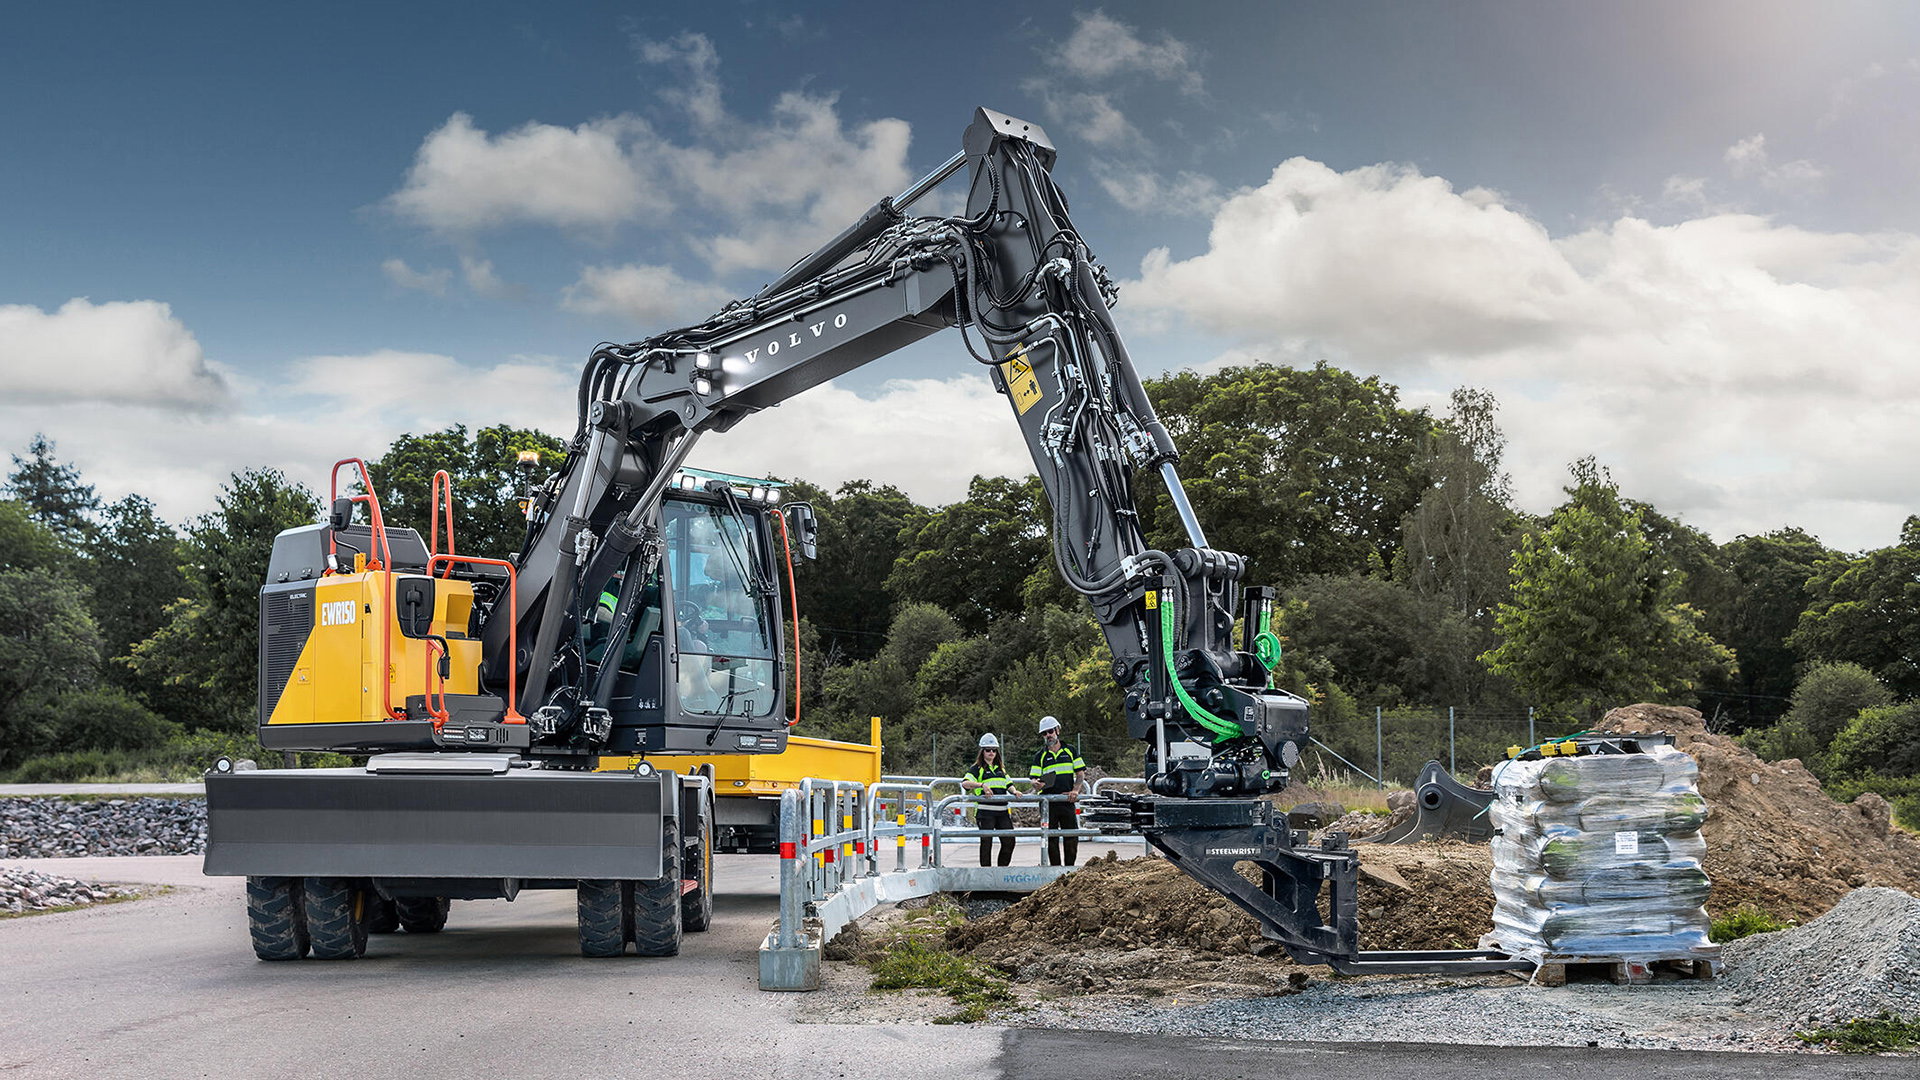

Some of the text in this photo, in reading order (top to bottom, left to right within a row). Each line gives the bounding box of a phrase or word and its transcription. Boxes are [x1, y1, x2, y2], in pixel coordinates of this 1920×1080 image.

[743, 313, 848, 364] VOLVO
[321, 600, 356, 627] EWR150
[1211, 847, 1256, 855] STEELWRIST
